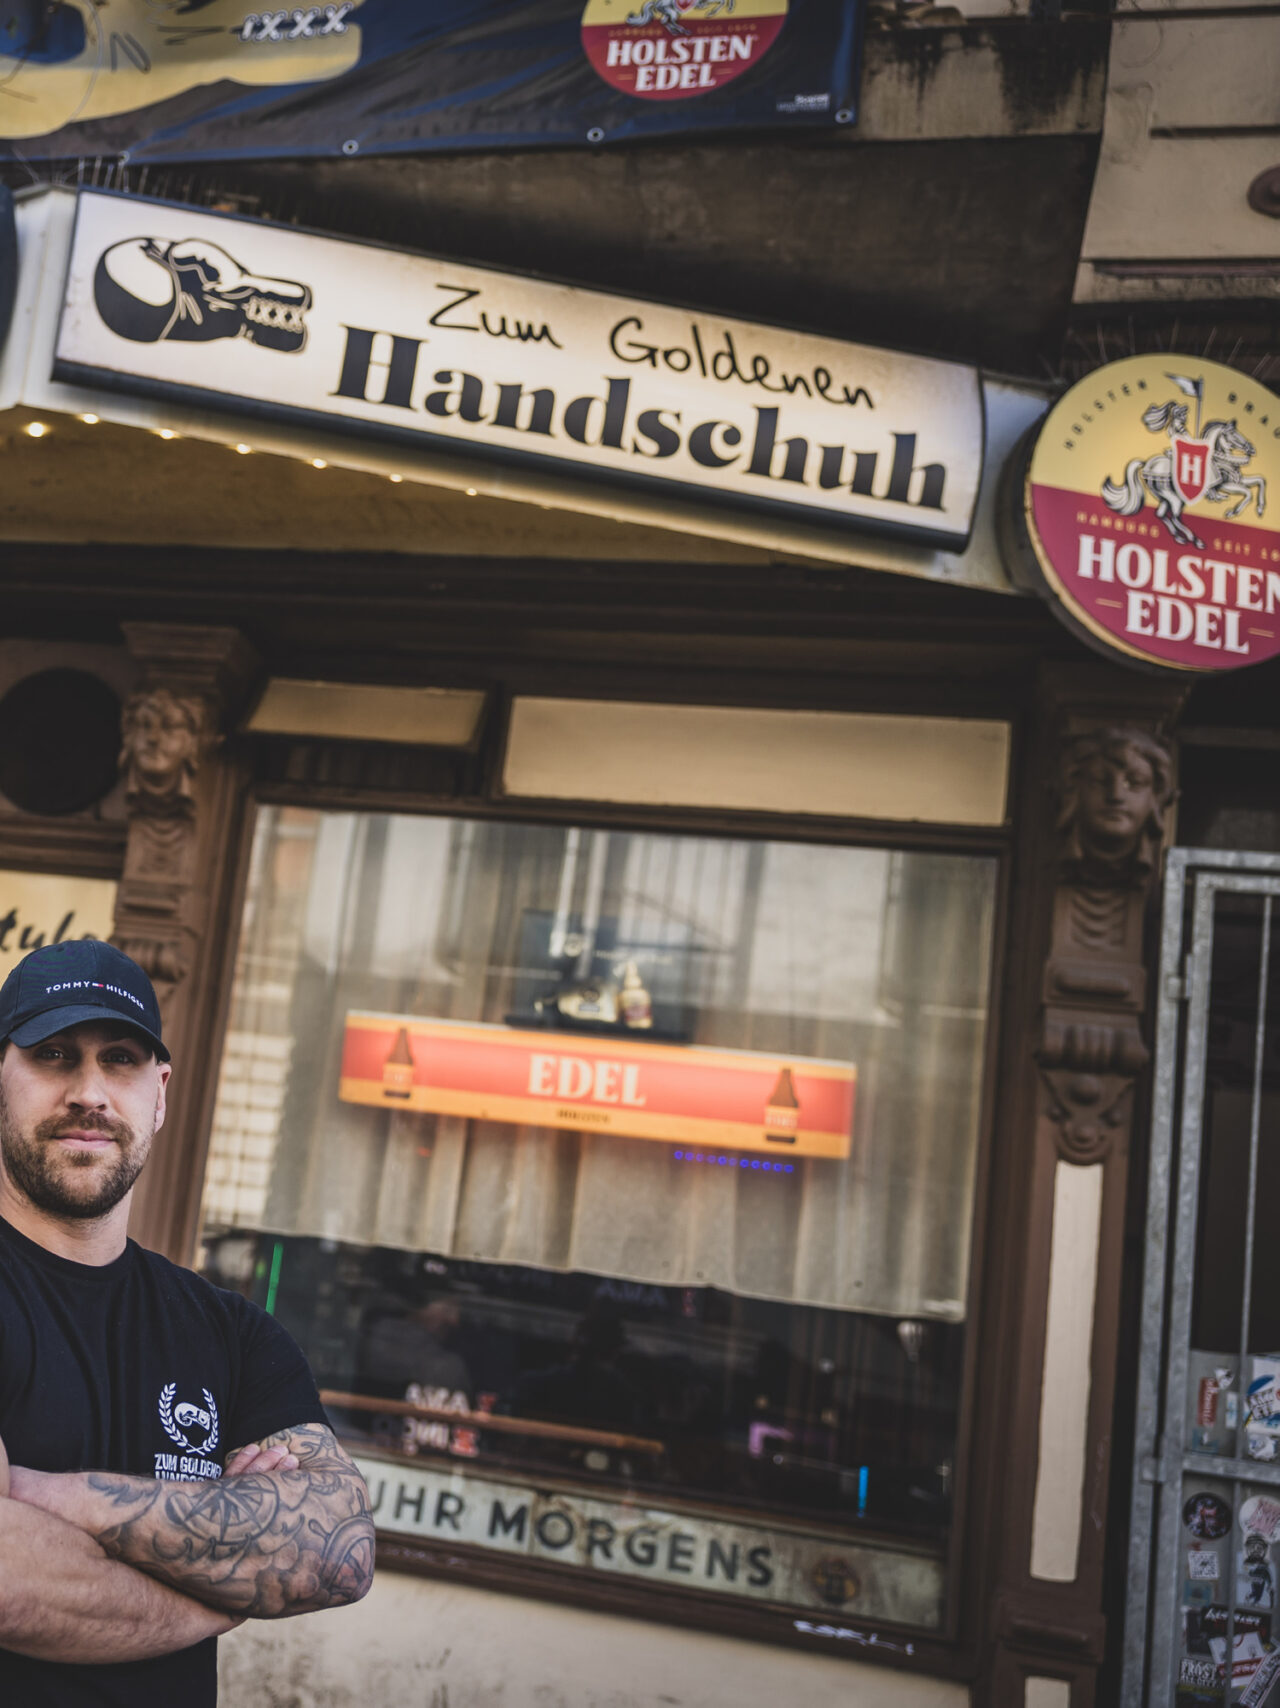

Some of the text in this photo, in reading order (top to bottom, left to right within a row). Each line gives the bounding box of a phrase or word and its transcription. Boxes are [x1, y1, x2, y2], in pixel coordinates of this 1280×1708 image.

[606, 34, 754, 67] HOLSTEN
[635, 63, 717, 92] EDEL
[428, 284, 877, 410] Zum Goldenen
[330, 323, 947, 512] Handschuh
[1180, 453, 1202, 487] H
[1125, 589, 1250, 654] EDEL
[46, 980, 145, 1011] TOMMY HILFIGER
[527, 1053, 648, 1105] EDEL
[154, 1453, 178, 1472] ZUM
[487, 1499, 775, 1587] MORGENS
